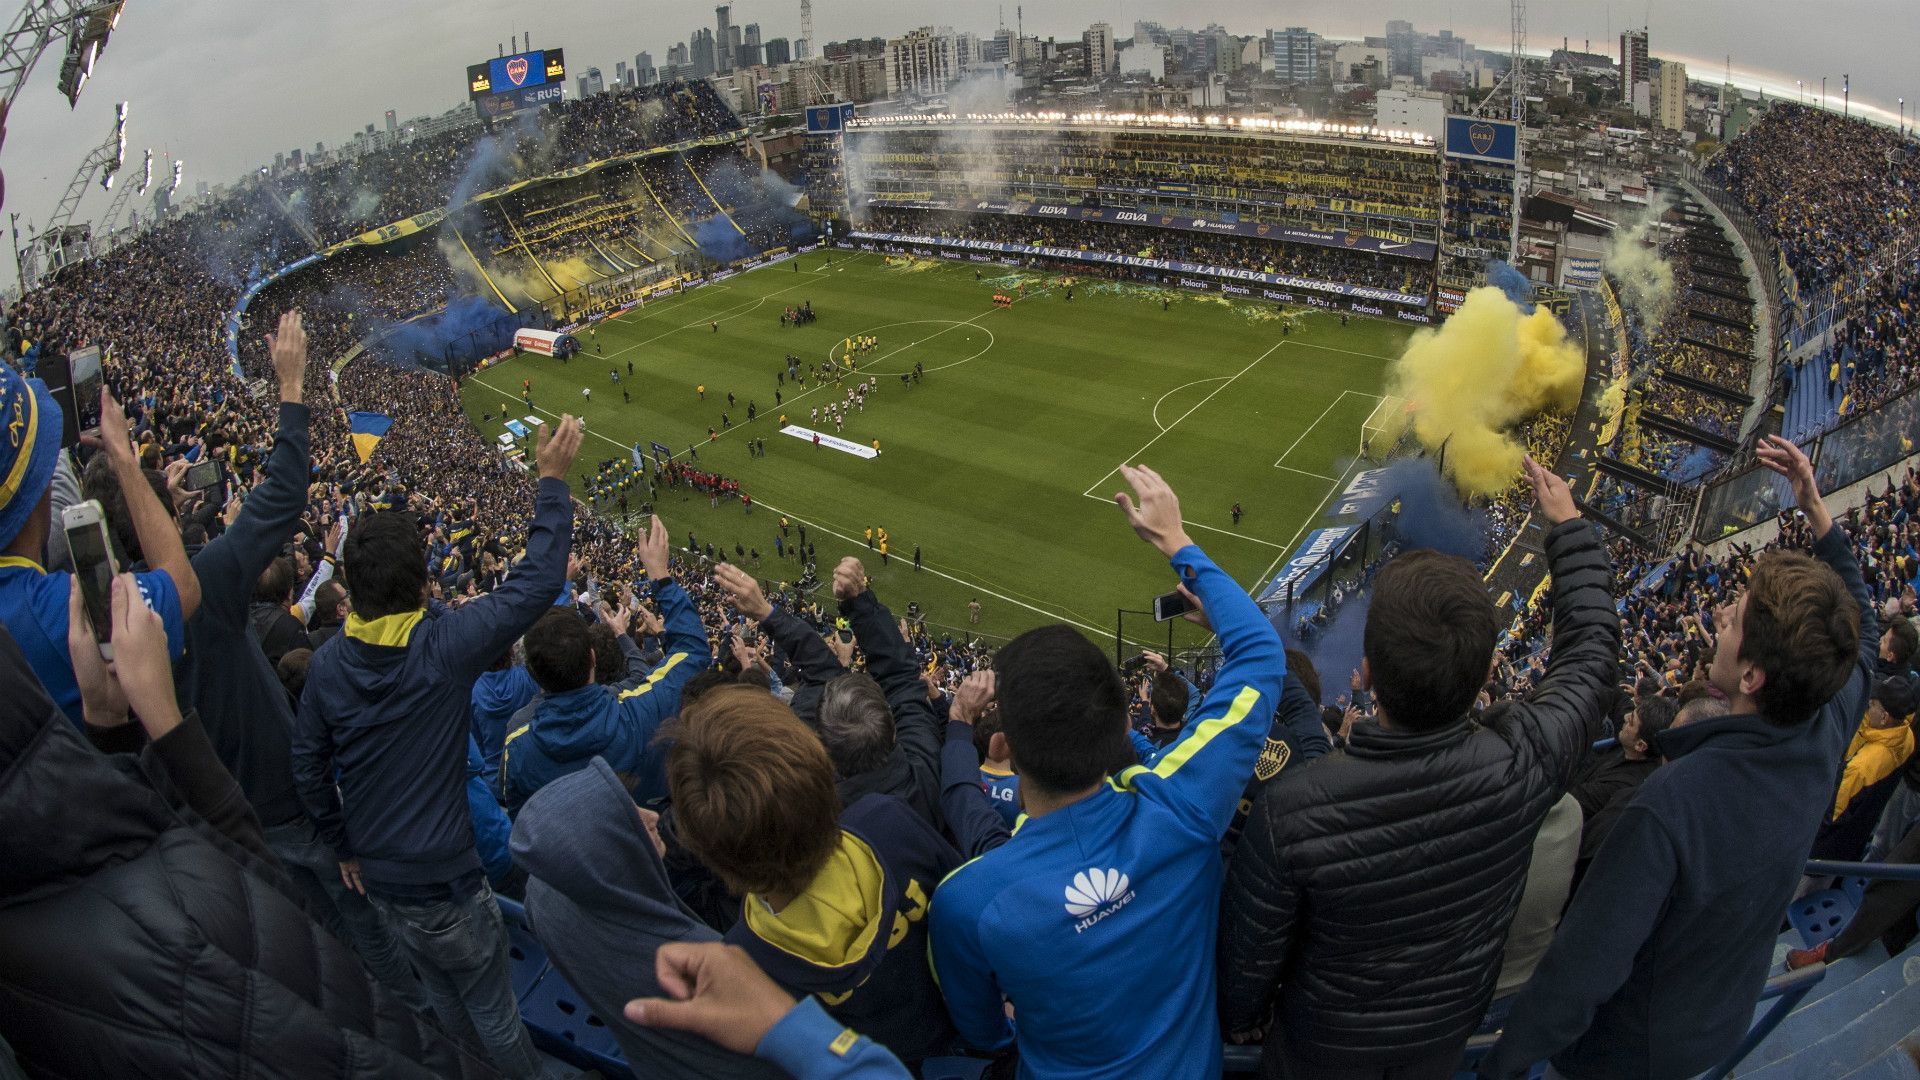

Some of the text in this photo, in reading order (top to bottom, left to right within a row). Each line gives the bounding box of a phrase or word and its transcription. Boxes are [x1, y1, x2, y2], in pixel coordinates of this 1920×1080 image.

[537, 87, 560, 100] RUS
[1038, 205, 1068, 216] BBVA
[1116, 211, 1148, 222] BBVA
[1206, 222, 1236, 230] HUAWEI
[950, 238, 1004, 250] LA NUEVA
[970, 254, 991, 262] Polacrin
[1023, 246, 1082, 258] LA NUEVA
[1104, 254, 1170, 270] LA NUEVA
[1195, 266, 1267, 282] LA NUEVA
[1180, 278, 1208, 289] Polacrin
[1221, 284, 1250, 295] Polacrin
[1276, 276, 1344, 294] autocrédito
[1264, 290, 1293, 301] Polacrin
[1352, 304, 1383, 316] Polacrin
[1398, 310, 1429, 323] Polacrin
[991, 785, 1014, 802] LG
[1075, 891, 1136, 934] HUAWEI
